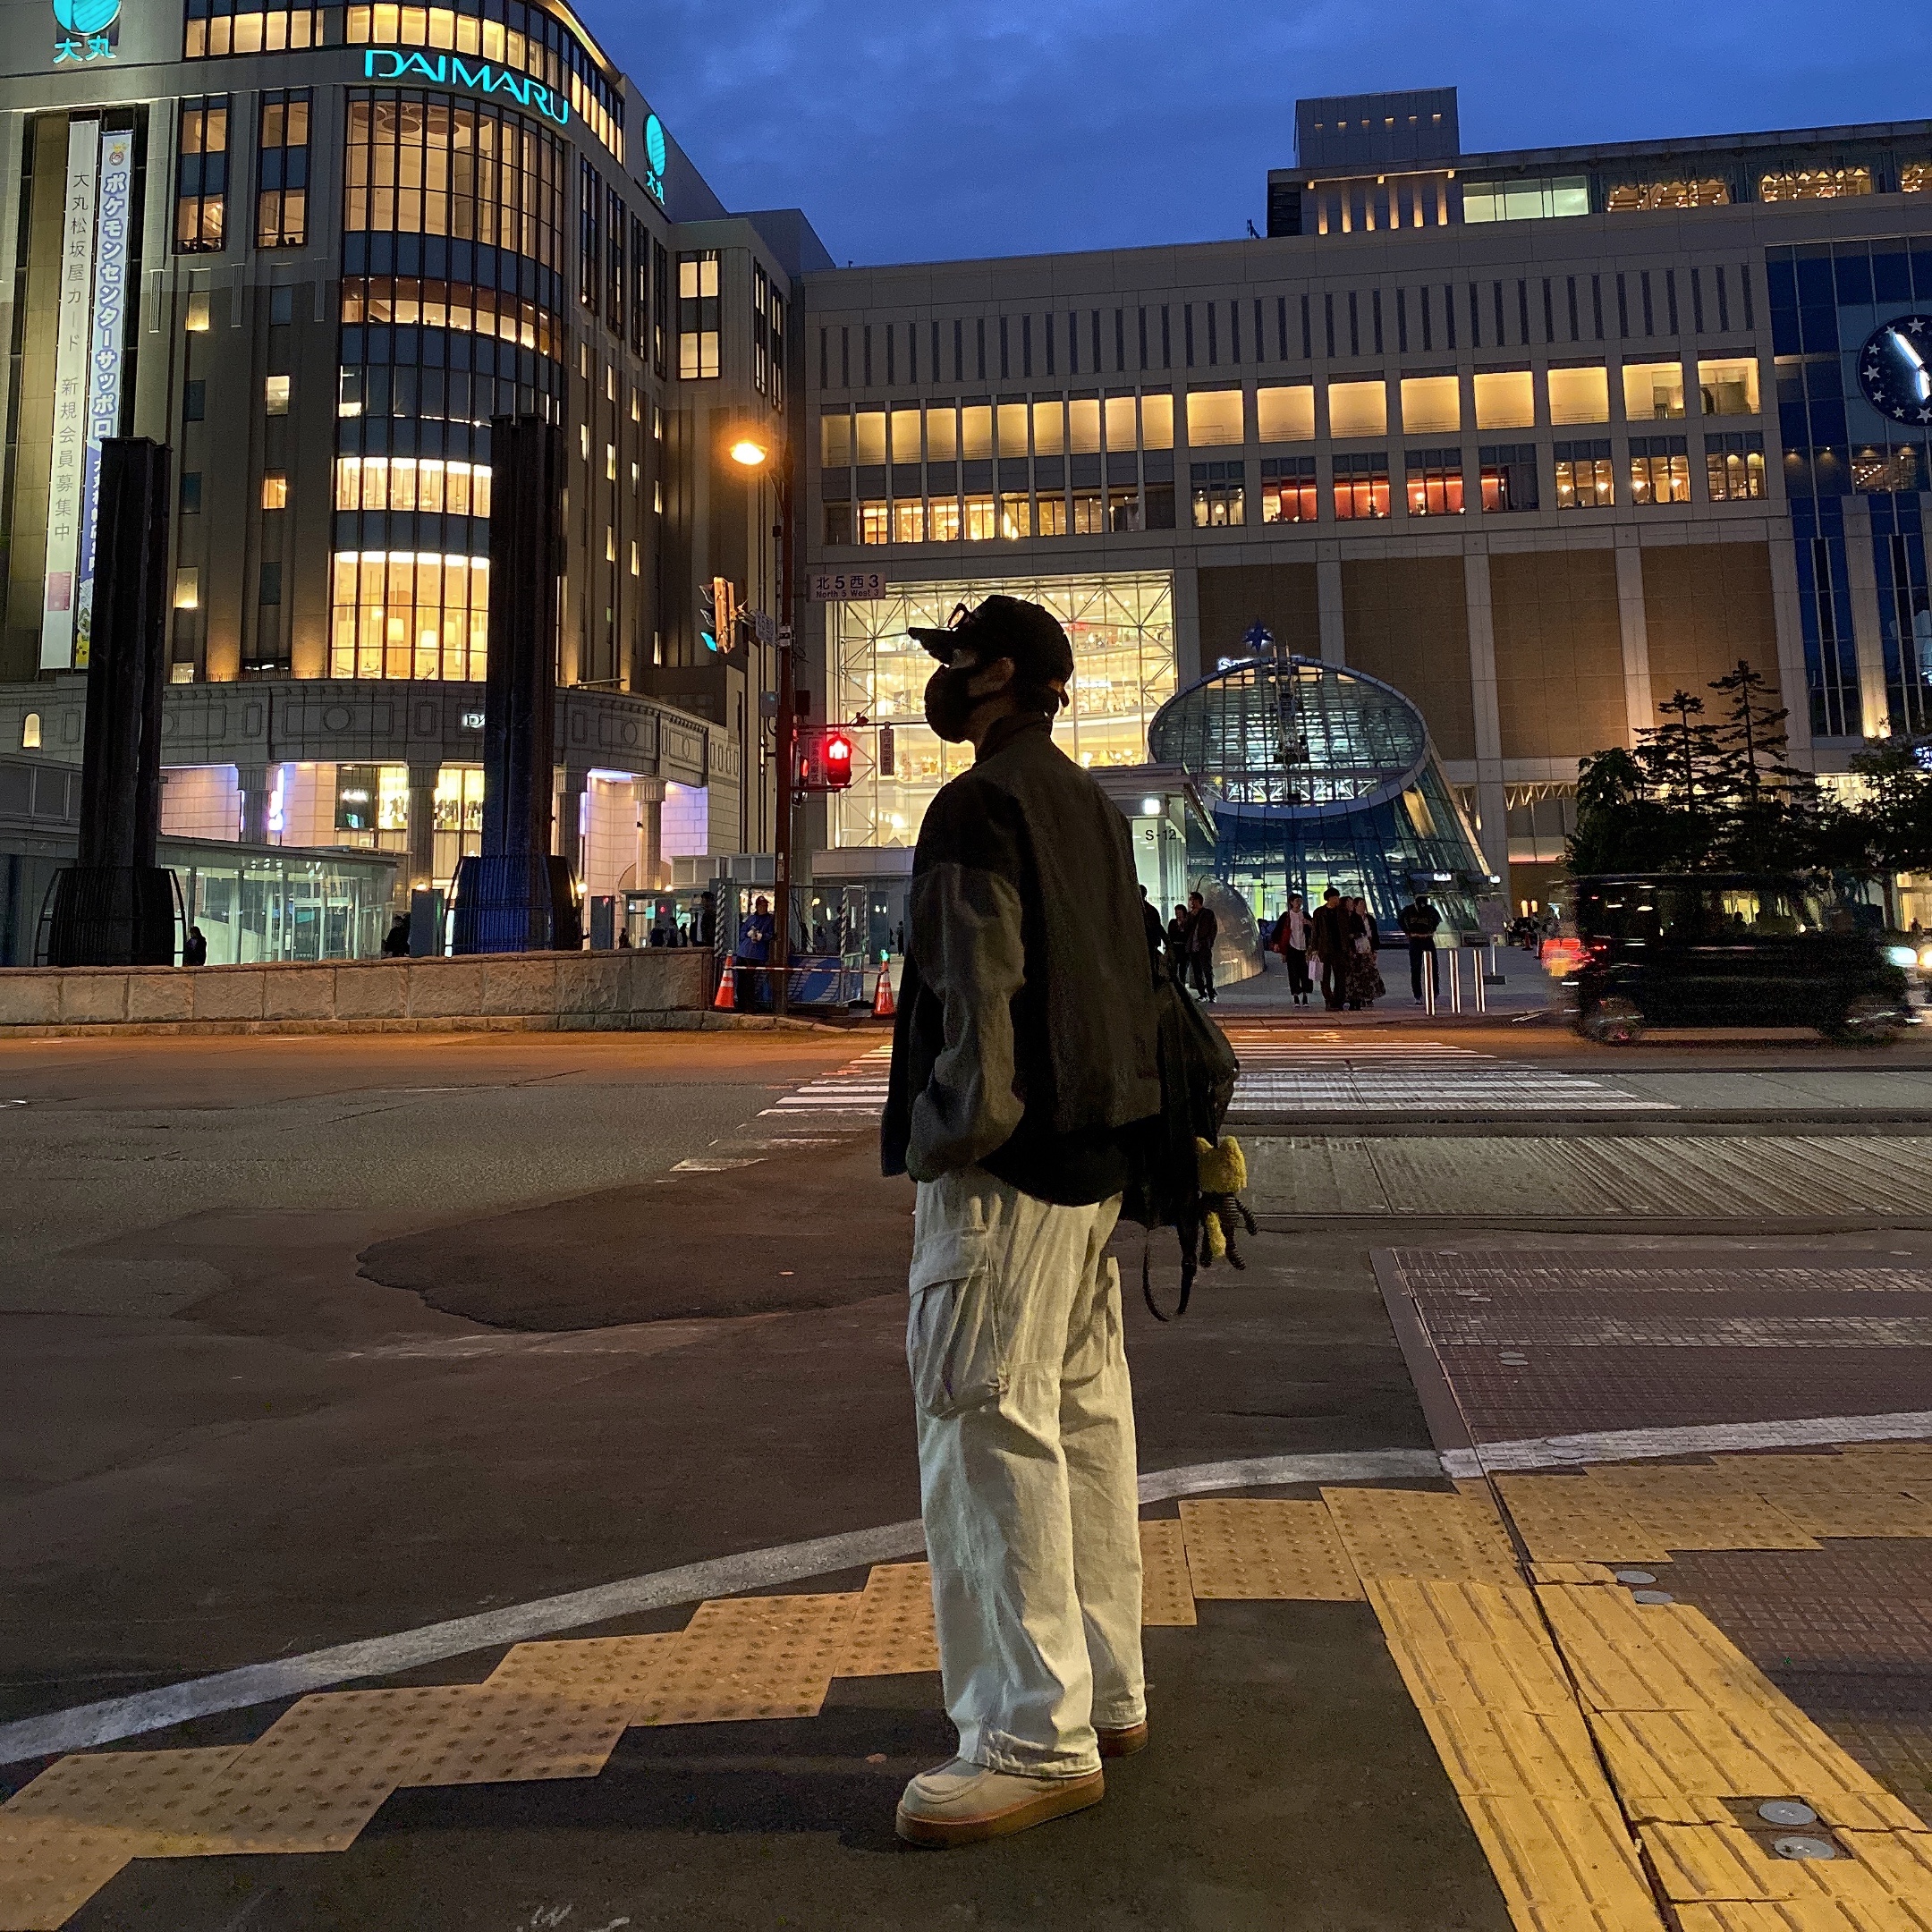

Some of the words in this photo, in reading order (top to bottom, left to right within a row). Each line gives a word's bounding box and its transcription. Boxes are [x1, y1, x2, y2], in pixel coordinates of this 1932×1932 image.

[53, 35, 117, 64] 大丸
[365, 50, 569, 124] DAIMARU
[646, 170, 665, 205] 大丸
[67, 173, 89, 352] 大丸松坂屋カード
[92, 173, 127, 439] ポケモンセンターサッポロ
[55, 377, 79, 541] 新規会員募集中
[816, 590, 838, 598] North
[842, 589, 847, 597] 5
[851, 589, 870, 597] West
[1145, 829, 1176, 841] S-12
